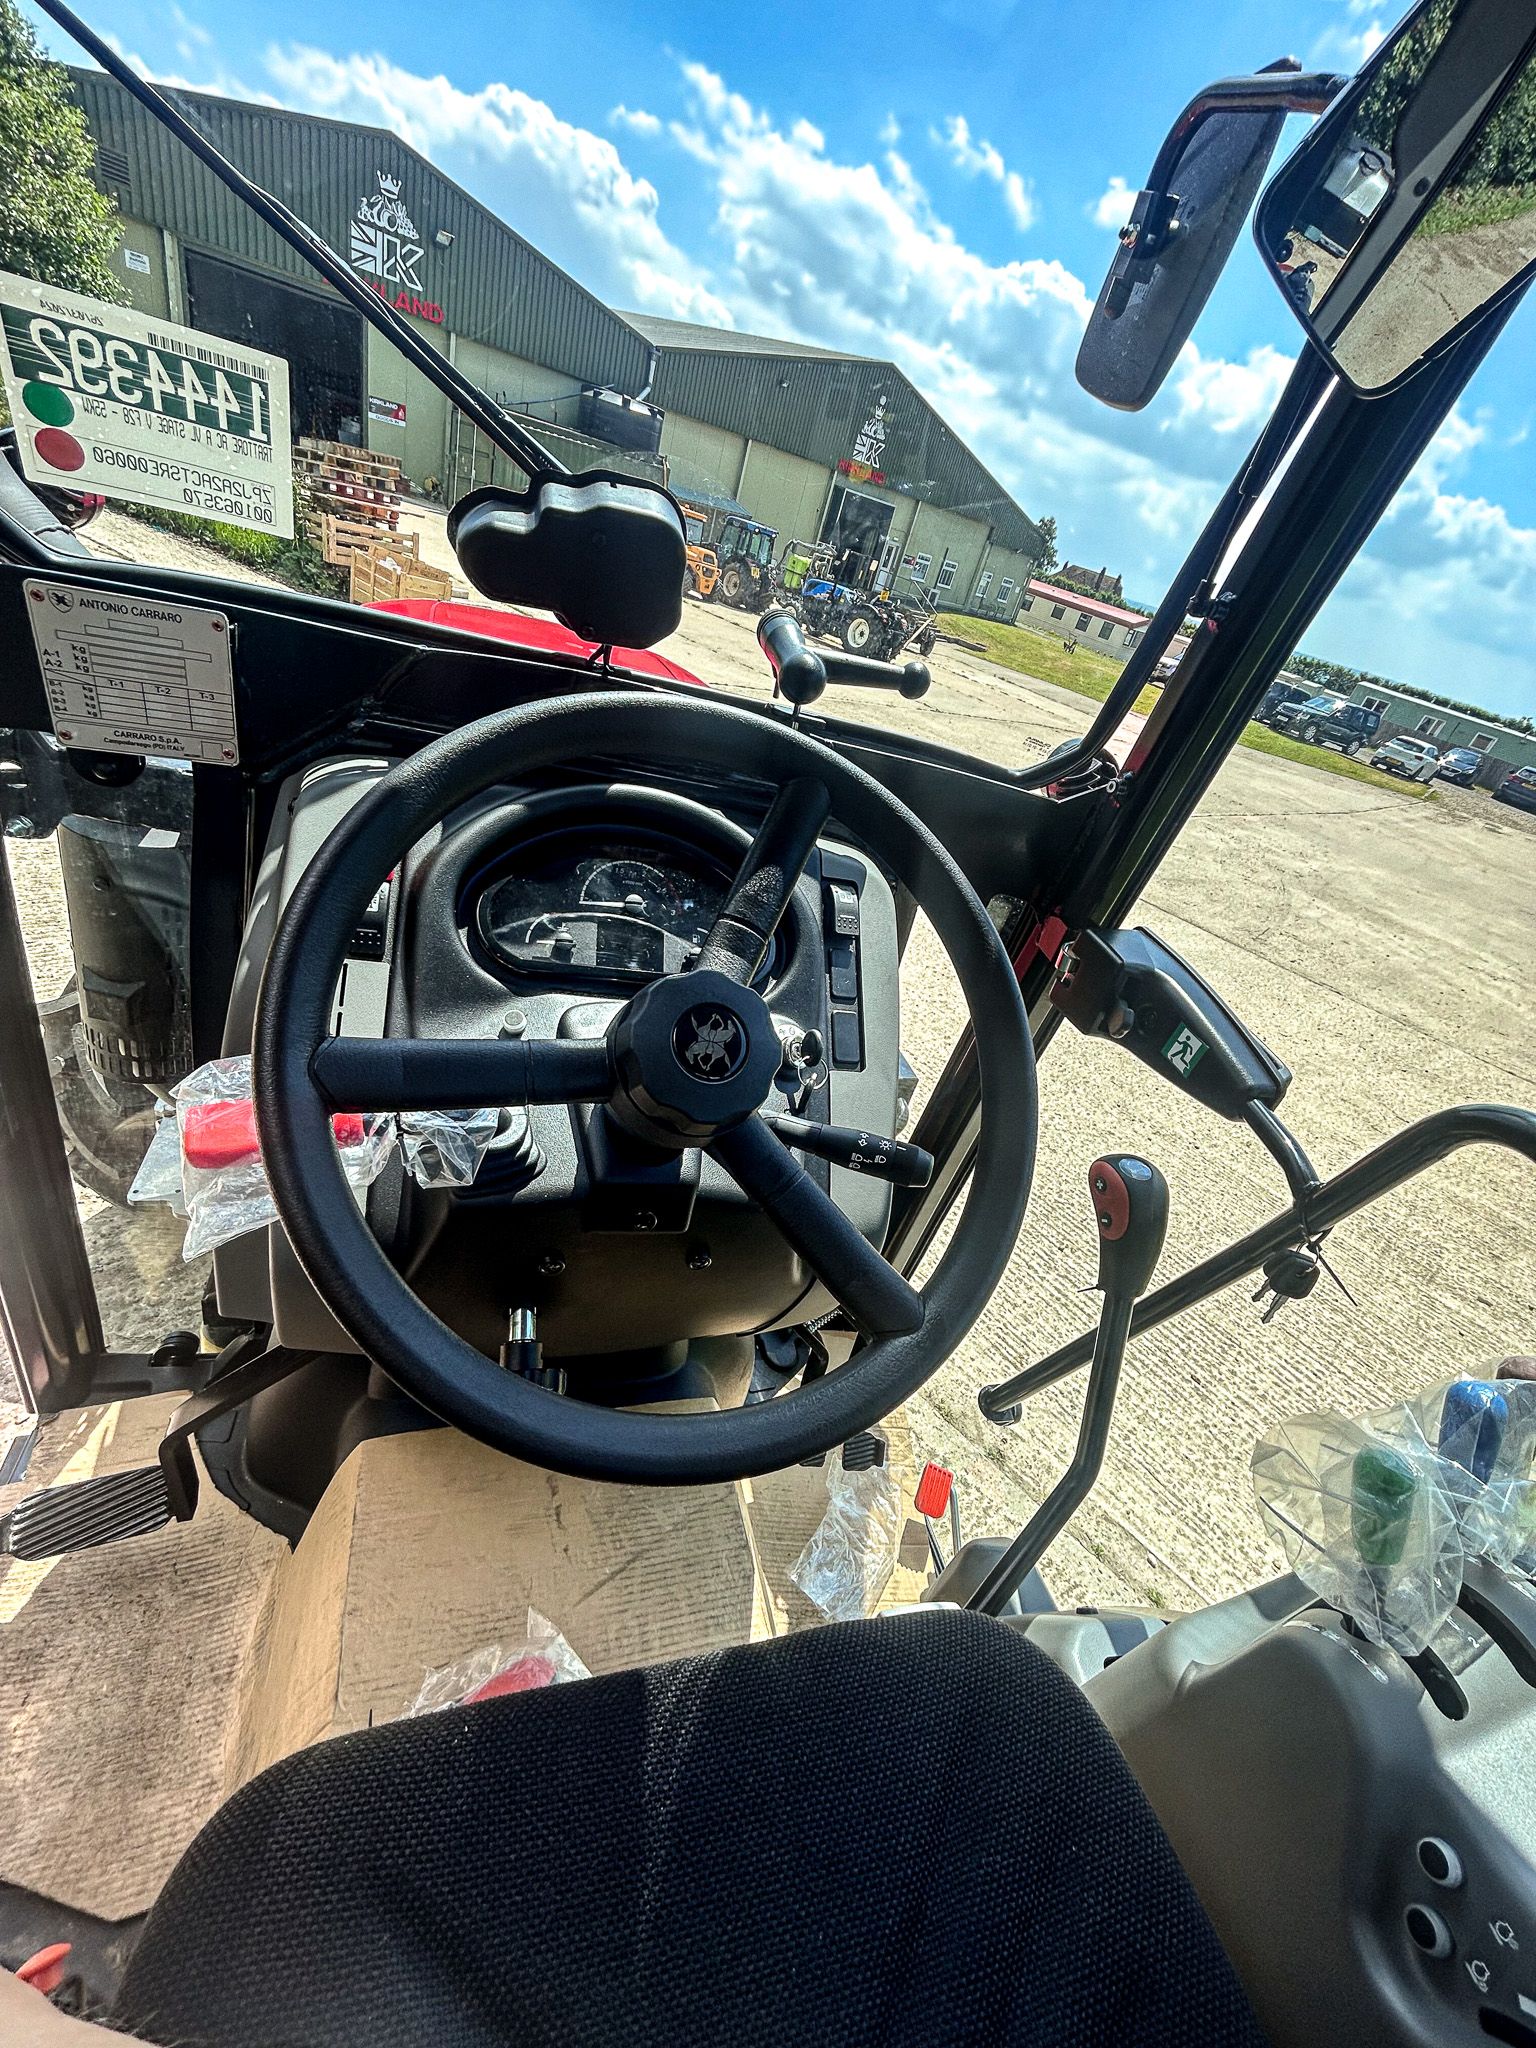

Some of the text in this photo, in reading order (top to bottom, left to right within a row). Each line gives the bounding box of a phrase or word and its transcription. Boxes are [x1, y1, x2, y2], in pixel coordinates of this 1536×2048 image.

[79, 597, 182, 624] ANTONIO CARRARO
[72, 643, 86, 654] kg
[43, 649, 88, 664] A-1 kg
[45, 659, 90, 673] A-2 kg
[108, 679, 215, 701] T-1 T-2 T-3
[114, 730, 182, 745] CARRARO S.p.A.
